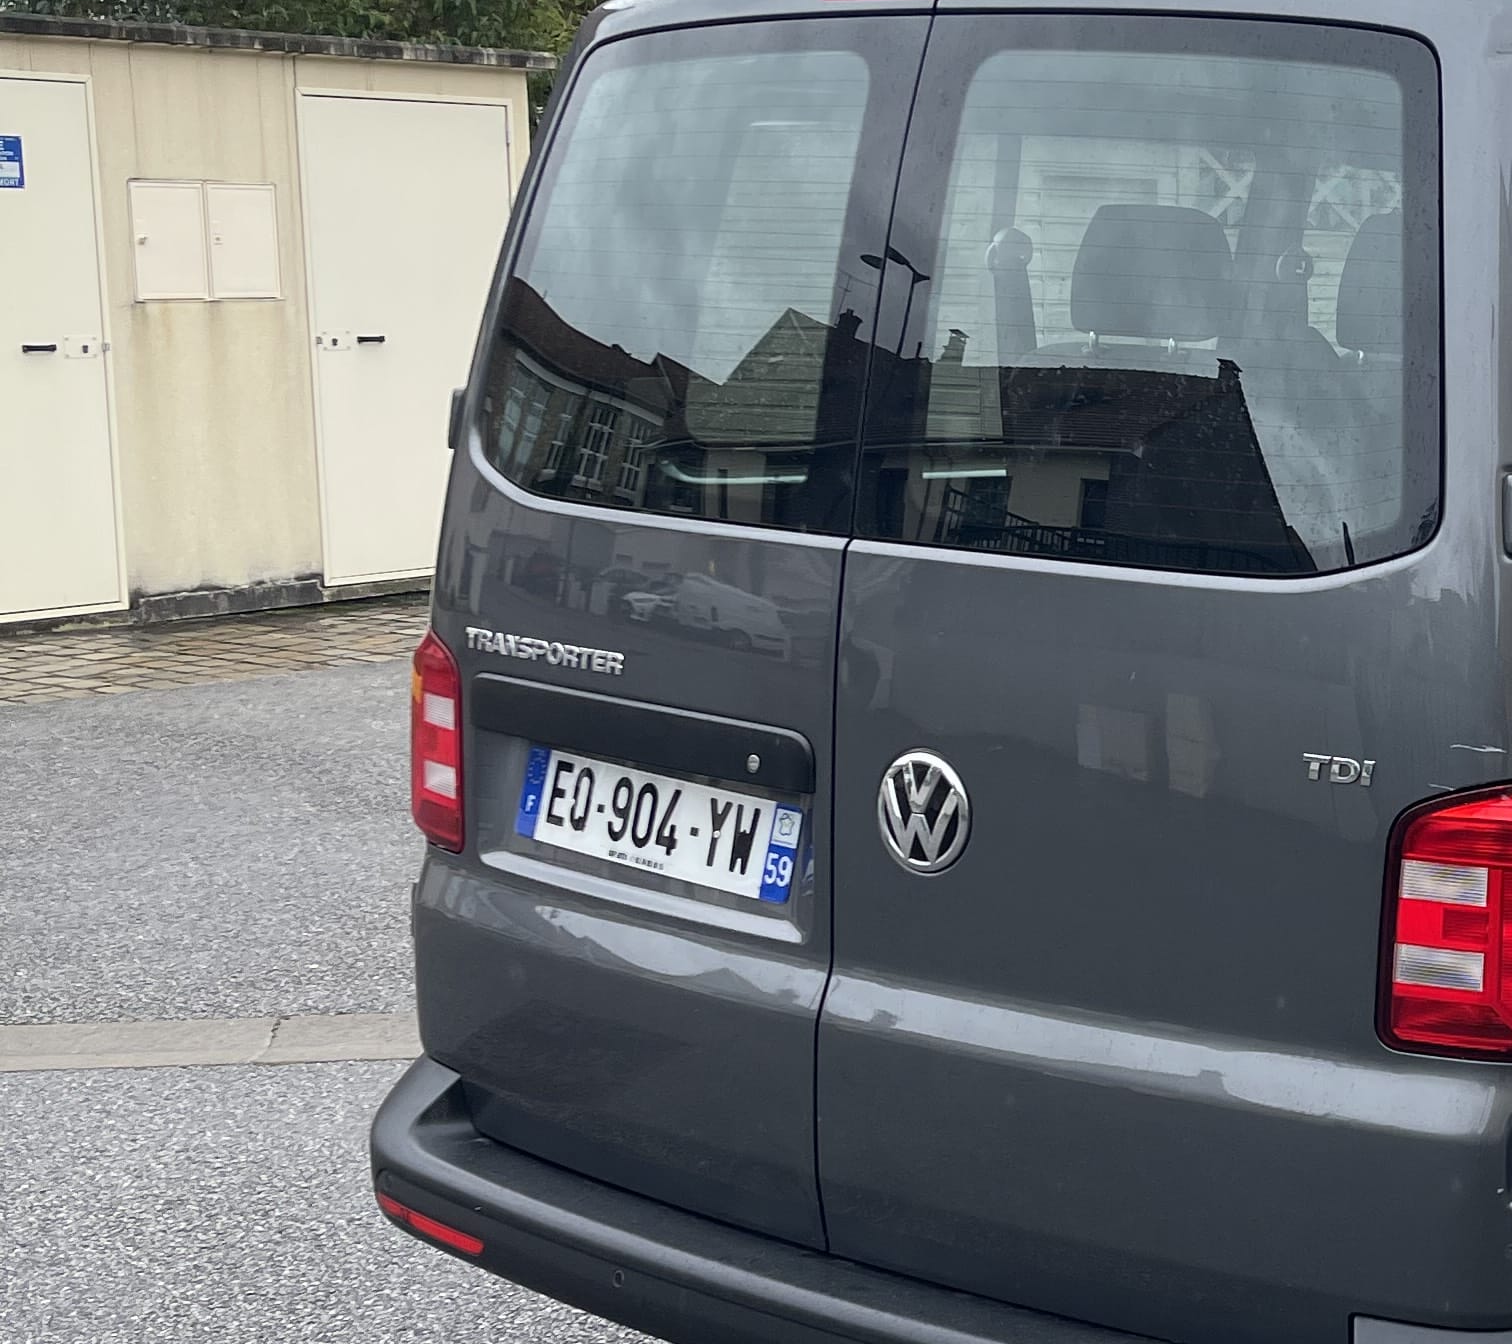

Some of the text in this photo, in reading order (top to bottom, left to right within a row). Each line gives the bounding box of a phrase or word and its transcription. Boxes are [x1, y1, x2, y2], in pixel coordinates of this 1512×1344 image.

[465, 626, 625, 676] TRANSPORTER
[1303, 752, 1376, 787] TDI
[524, 794, 536, 813] F
[764, 852, 794, 888] 59
